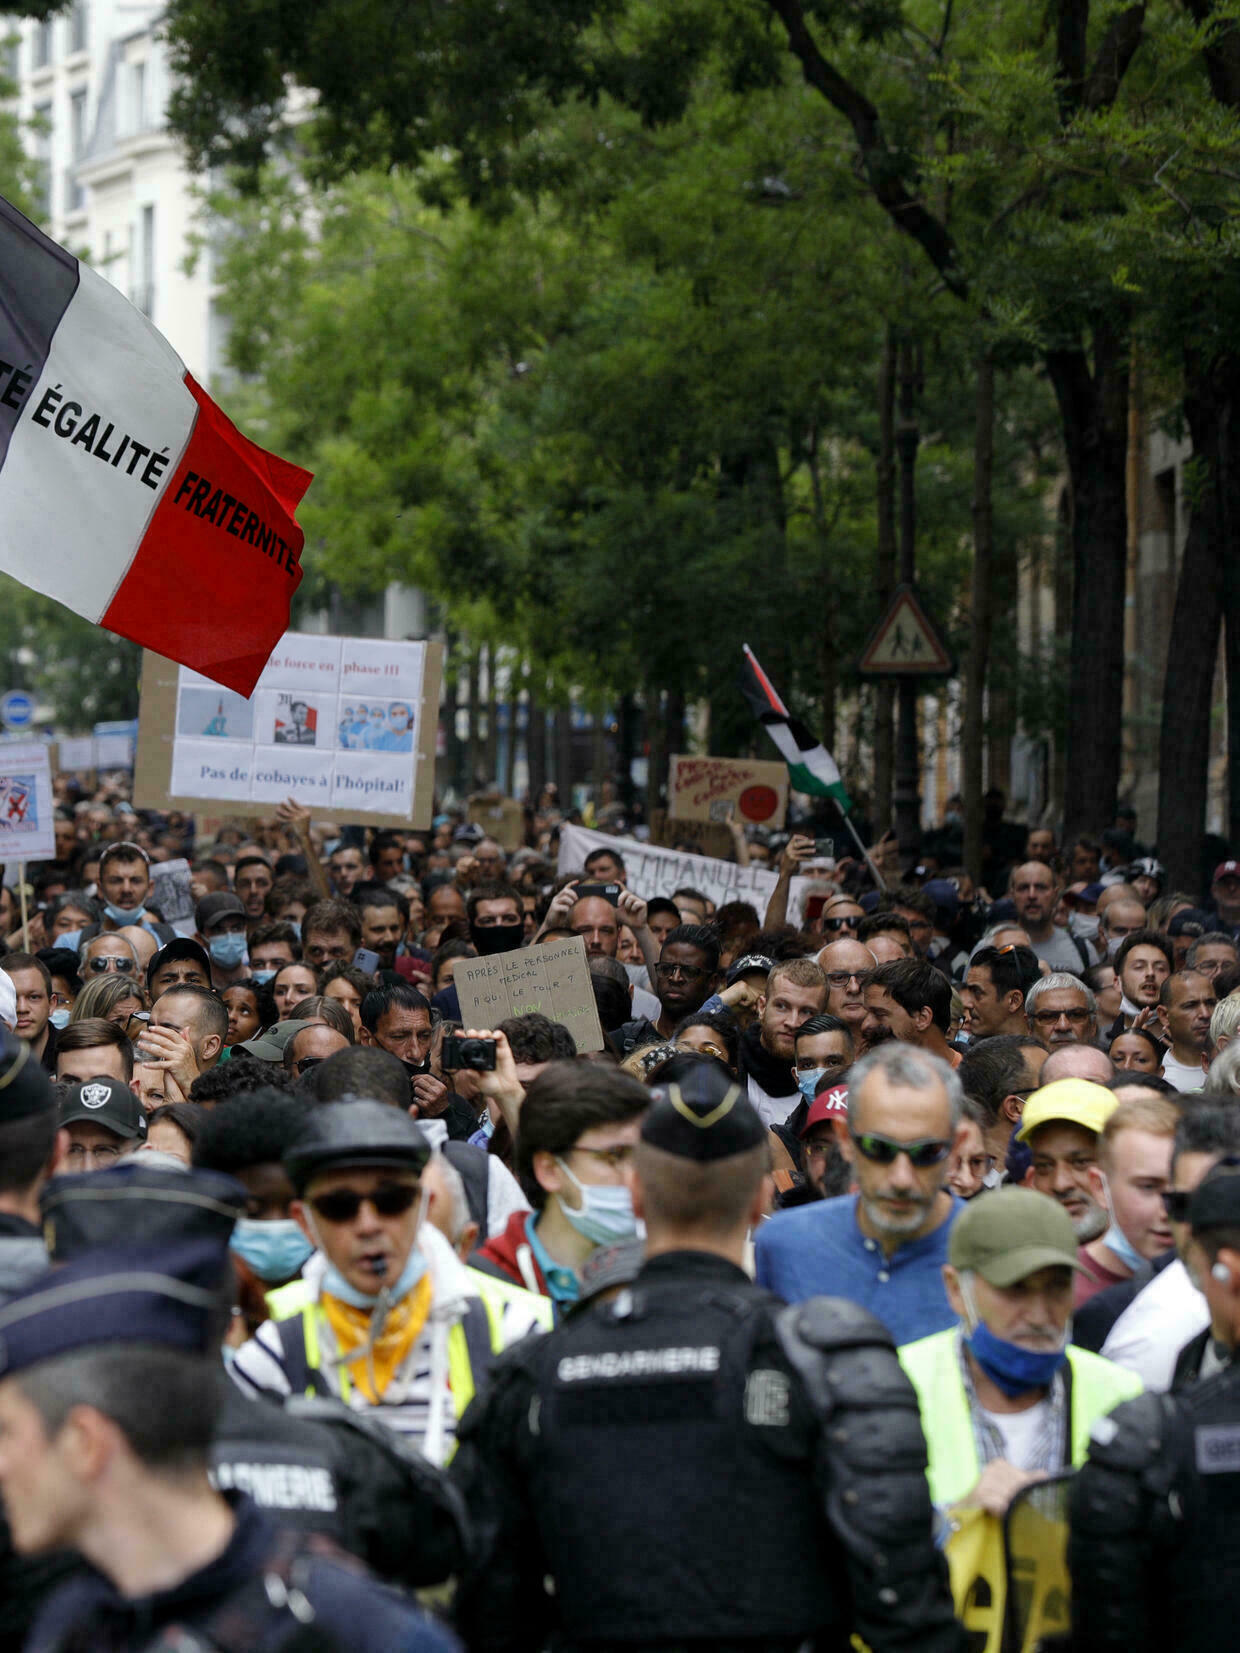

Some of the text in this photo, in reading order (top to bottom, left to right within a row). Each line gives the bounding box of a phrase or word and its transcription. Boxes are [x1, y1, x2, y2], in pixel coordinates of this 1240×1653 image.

[31, 384, 171, 490] ÉGALITÉ
[320, 662, 335, 672] en
[200, 765, 226, 780] Pas
[230, 768, 249, 782] de
[256, 769, 316, 788] cobayes
[505, 962, 519, 971] LE
[524, 946, 580, 967] PERSONNEL
[512, 988, 525, 997] LE
[532, 981, 561, 992] TOUR
[567, 975, 575, 984] ?
[558, 1346, 721, 1382] GENDARMERIE
